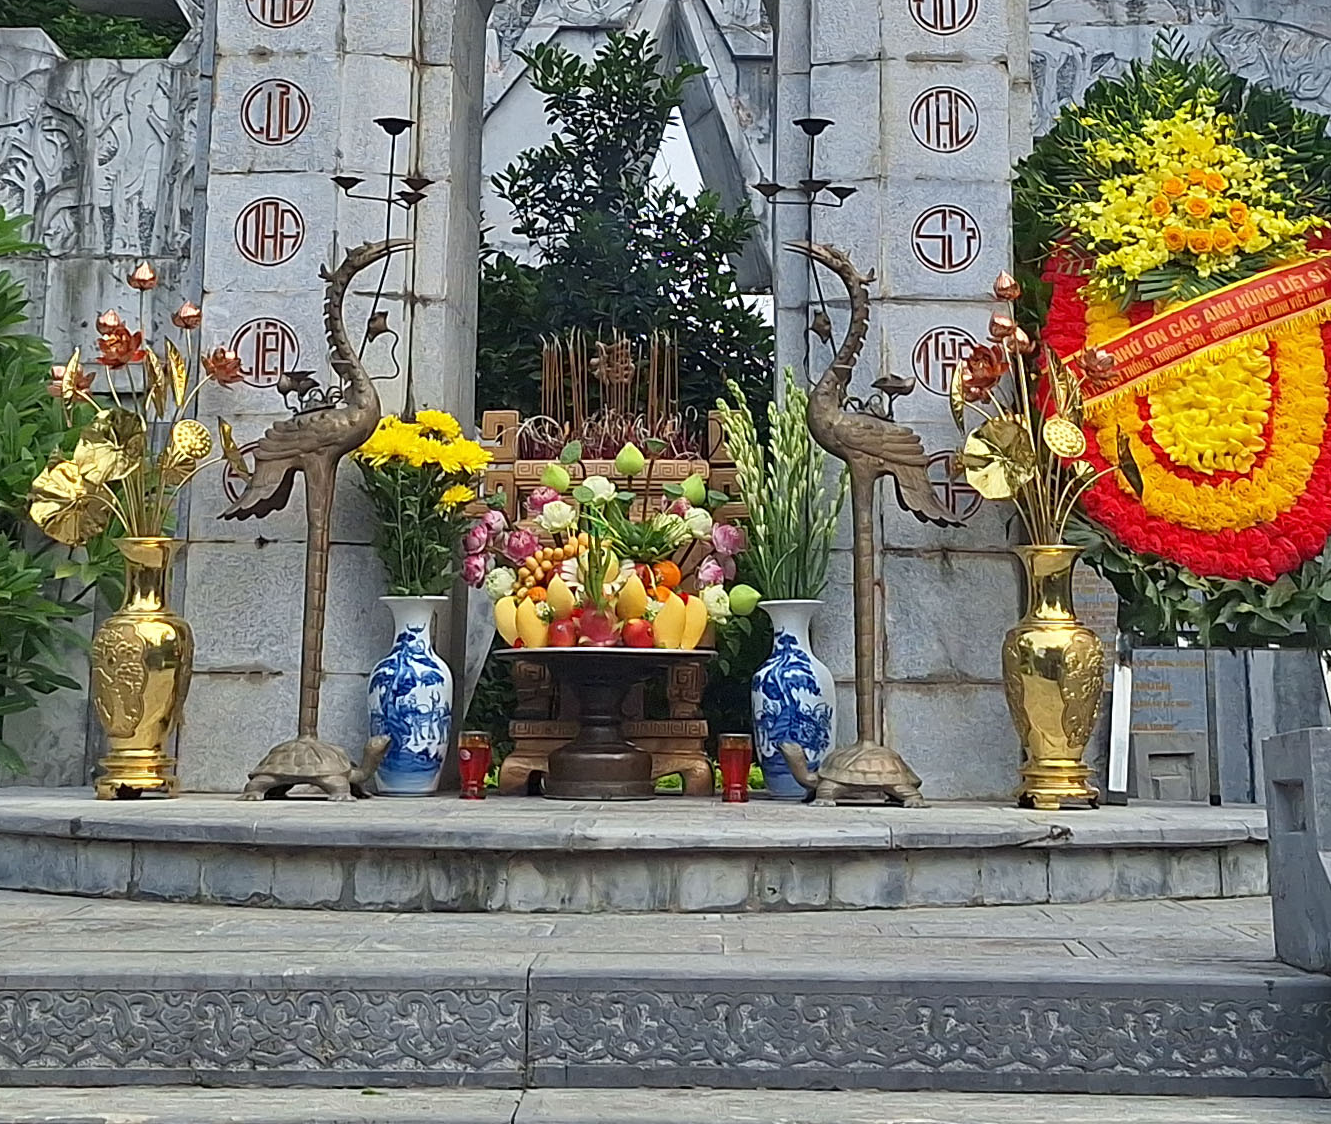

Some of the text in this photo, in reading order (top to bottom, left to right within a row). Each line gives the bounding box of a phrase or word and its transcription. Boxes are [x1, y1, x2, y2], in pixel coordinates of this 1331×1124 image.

[1143, 329, 1168, 349] ƠN
[1168, 314, 1201, 338] CÁC
[1202, 300, 1236, 323] ANH
[1235, 283, 1279, 309] HÙNG
[1277, 274, 1308, 294] LIỆT
